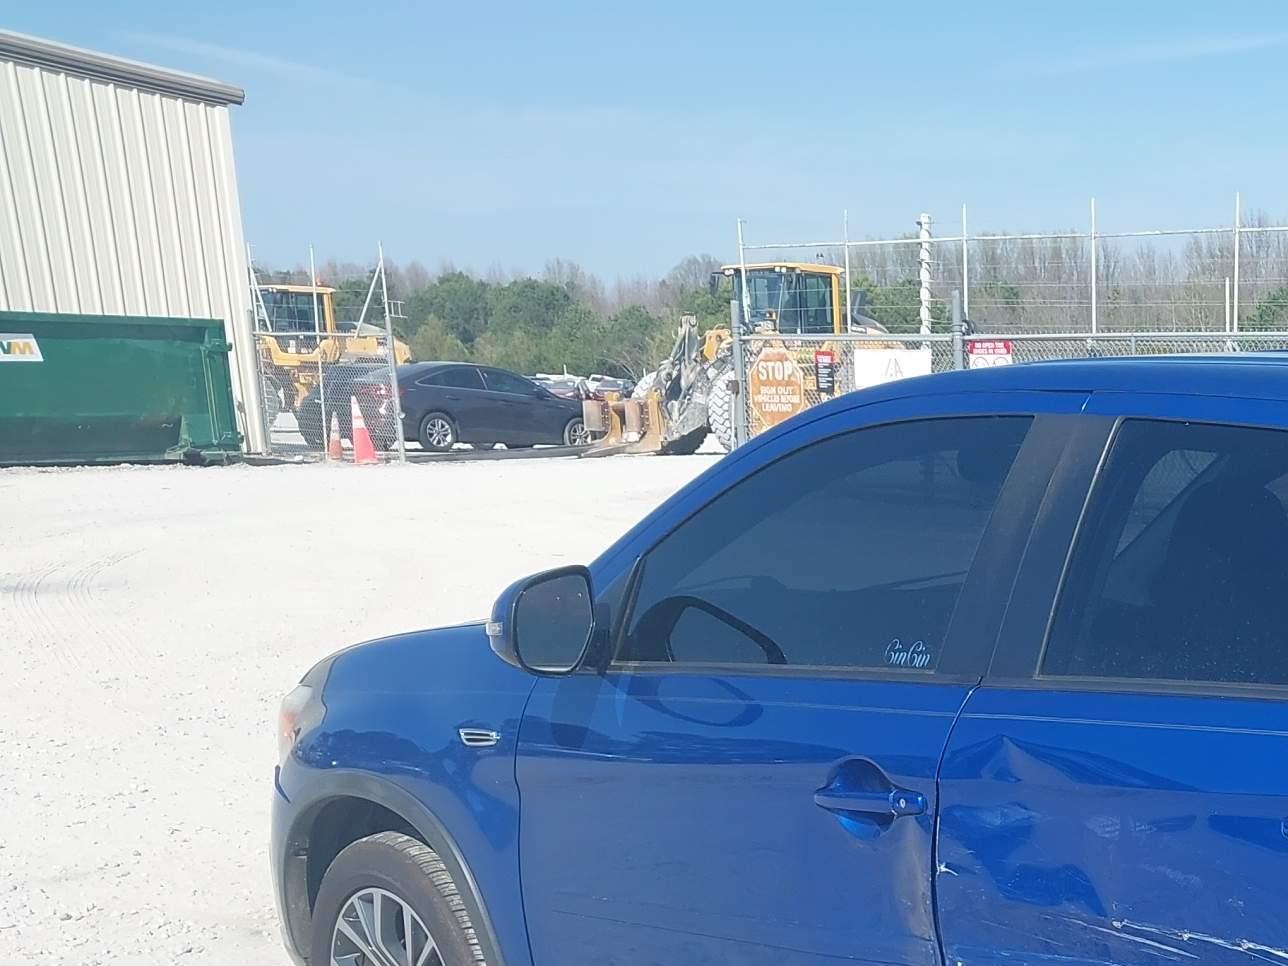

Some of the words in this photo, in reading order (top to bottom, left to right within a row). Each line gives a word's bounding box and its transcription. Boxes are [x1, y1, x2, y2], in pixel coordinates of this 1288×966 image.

[758, 360, 793, 381] STOP
[777, 385, 793, 394] OUT
[761, 403, 793, 412] LEAVING
